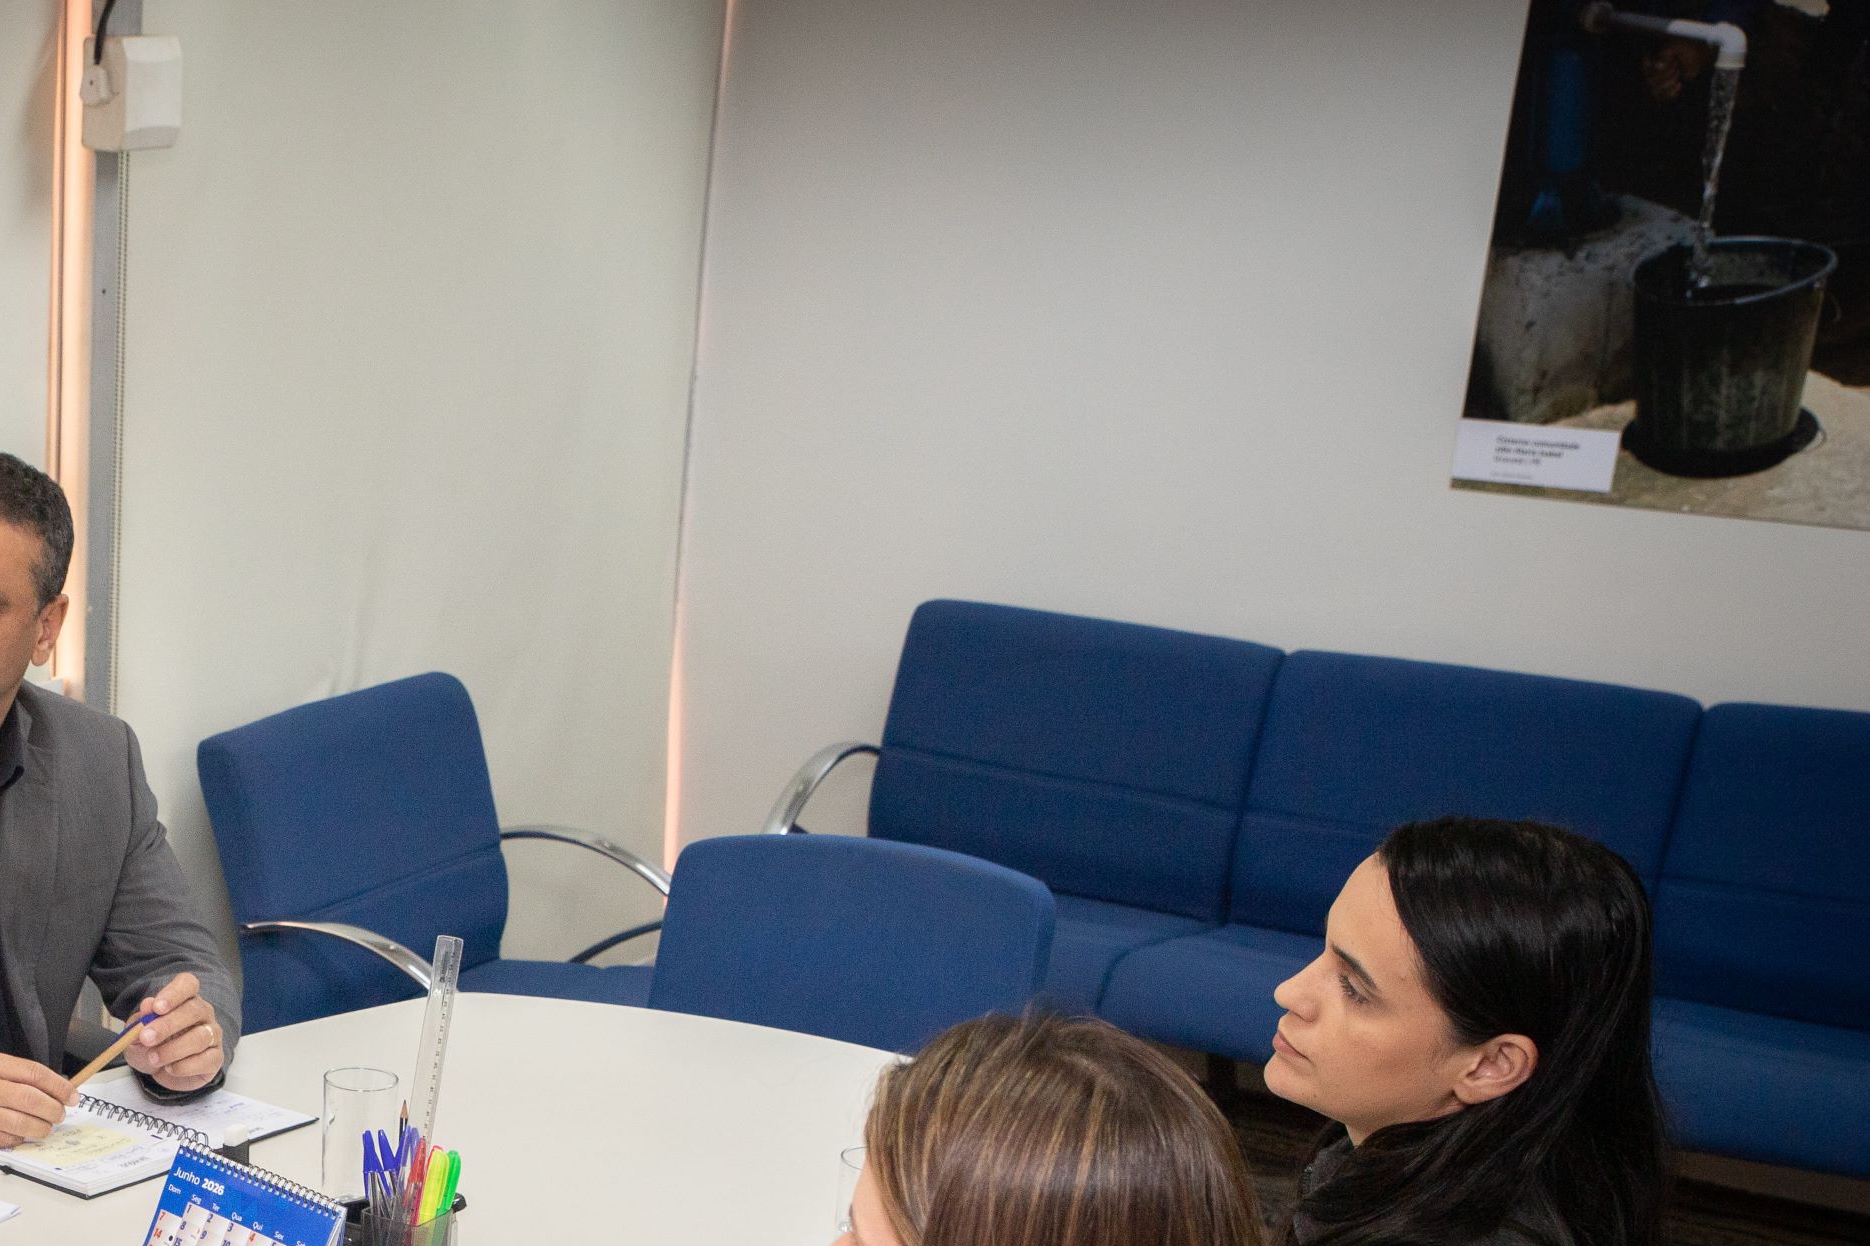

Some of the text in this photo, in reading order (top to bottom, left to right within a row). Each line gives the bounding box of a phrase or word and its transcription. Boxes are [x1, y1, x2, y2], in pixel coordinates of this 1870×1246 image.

[173, 1166, 225, 1195] Junho 2026
[159, 1211, 166, 1220] 7
[180, 1221, 186, 1230] 8
[200, 1230, 207, 1239] 9
[168, 1183, 182, 1195] Dom
[191, 1194, 202, 1205] Seg
[212, 1203, 220, 1211] Ter
[231, 1211, 243, 1222] Qua
[252, 1221, 264, 1231] Qui
[274, 1231, 284, 1240] Sex
[186, 1204, 192, 1213] 1
[207, 1213, 214, 1223] 2
[227, 1222, 234, 1232] 3
[249, 1232, 256, 1242] 4
[153, 1228, 162, 1239] 14
